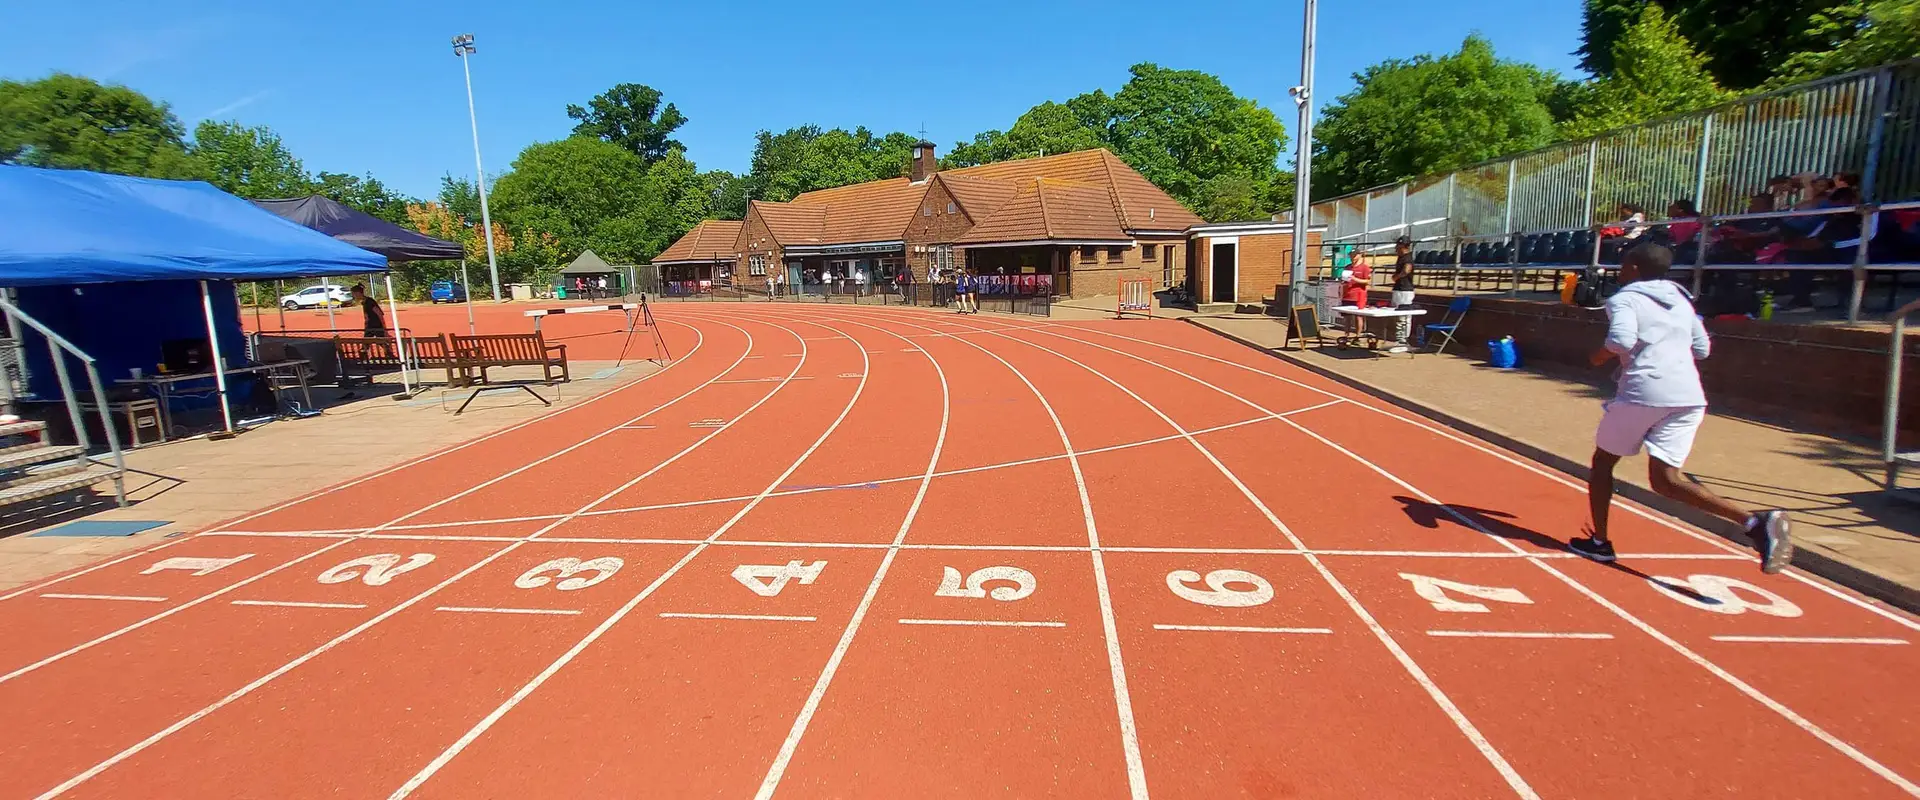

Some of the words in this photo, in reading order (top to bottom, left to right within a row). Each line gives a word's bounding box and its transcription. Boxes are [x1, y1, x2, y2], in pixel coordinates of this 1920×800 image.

[140, 553, 256, 576] 1
[317, 553, 436, 586] 2
[514, 557, 624, 590] 3
[731, 560, 827, 596] 4
[935, 566, 1036, 601] 5
[1166, 569, 1274, 607] 6
[1399, 573, 1534, 612] 7
[1644, 574, 1803, 617] 8
